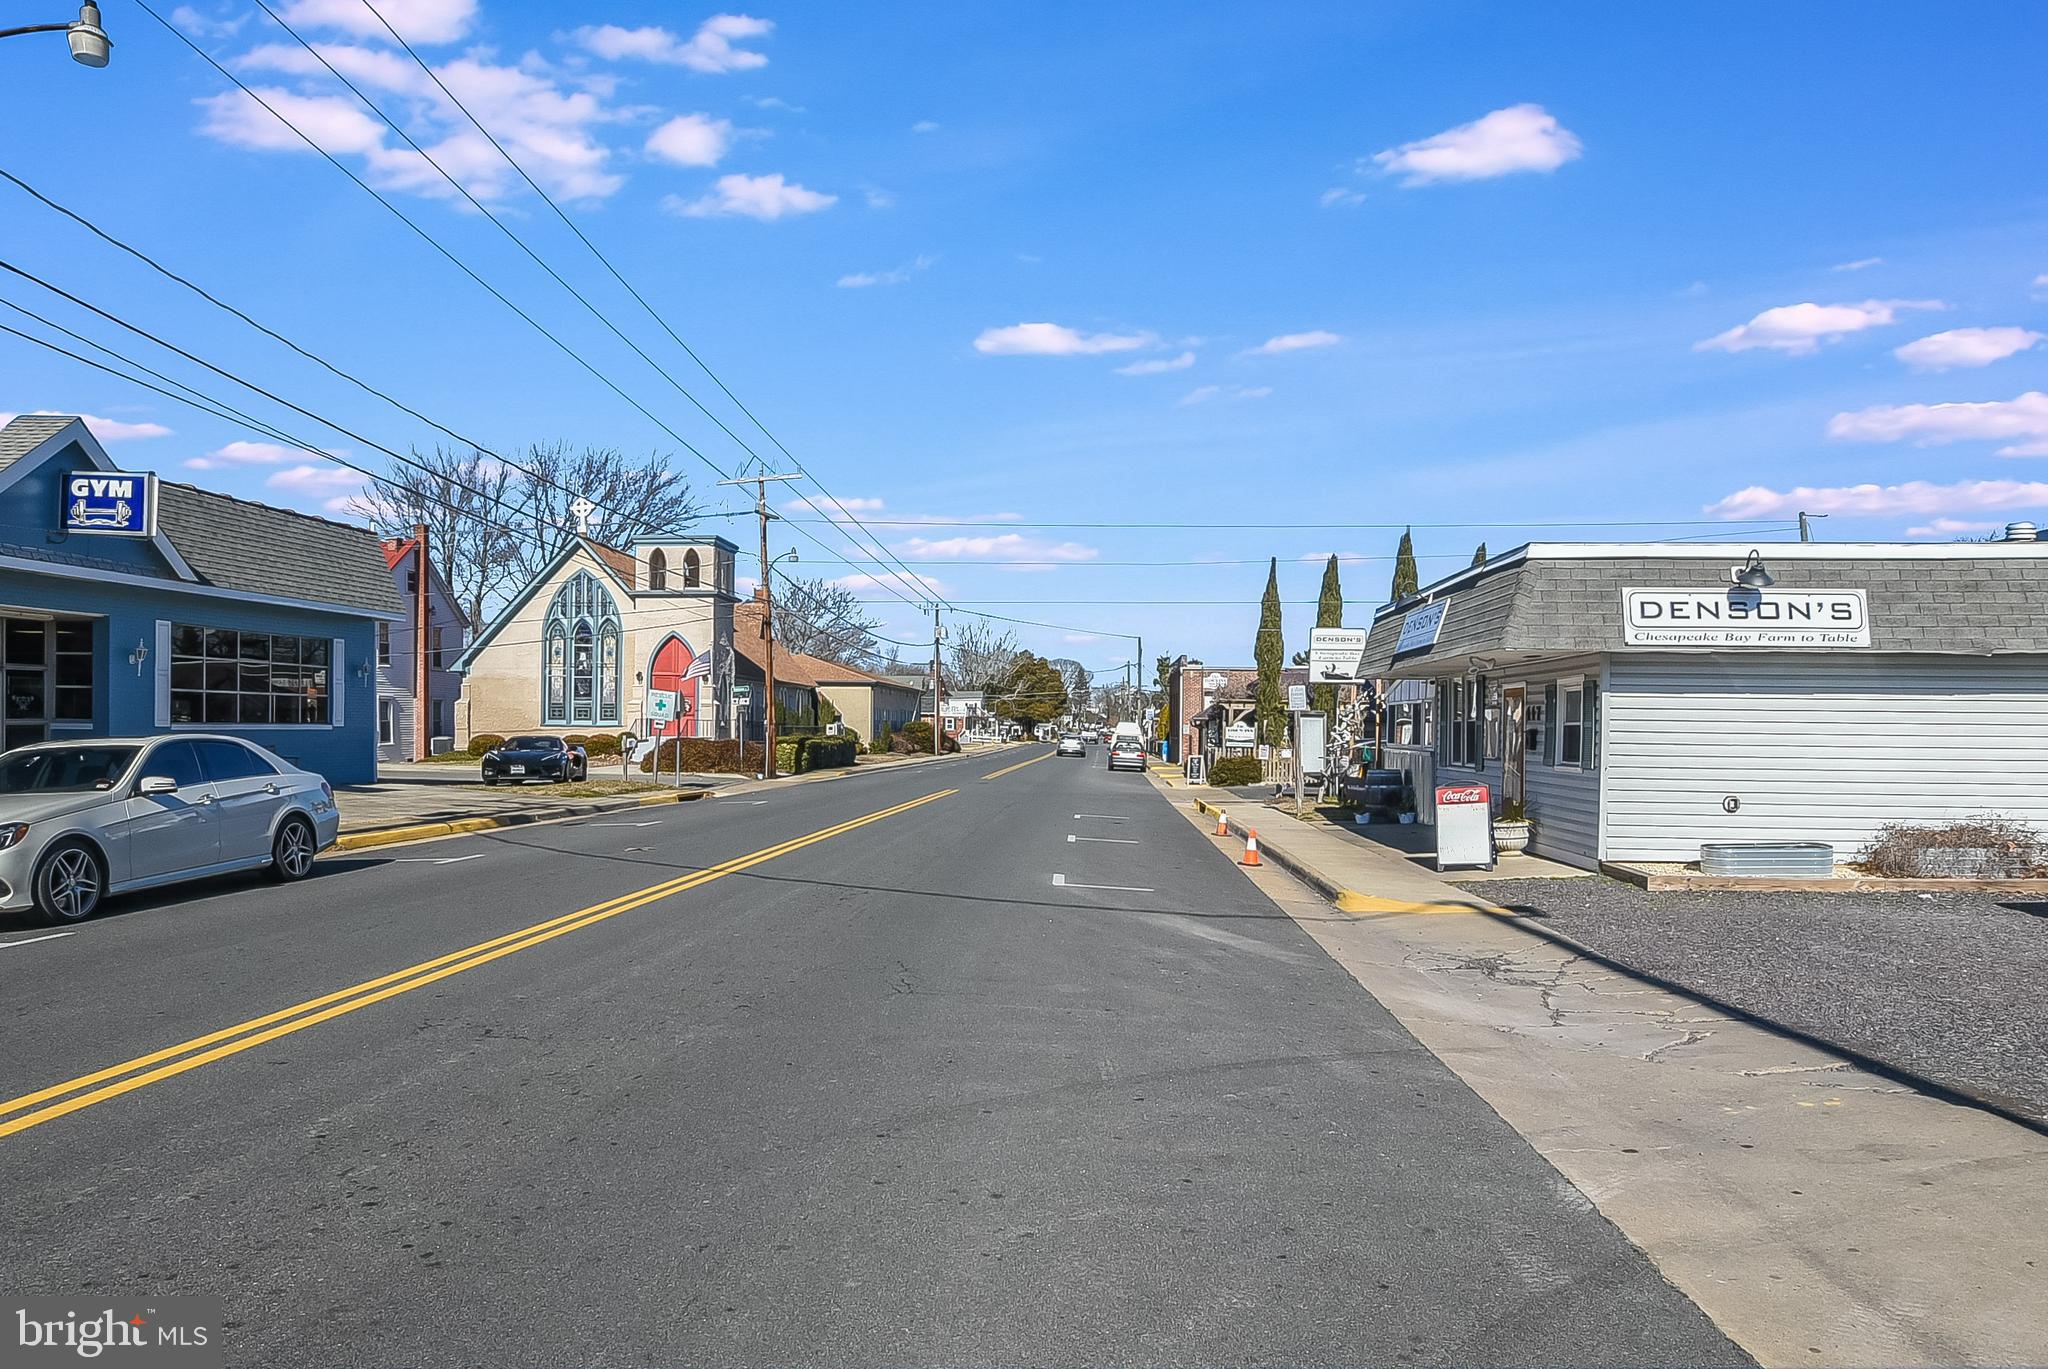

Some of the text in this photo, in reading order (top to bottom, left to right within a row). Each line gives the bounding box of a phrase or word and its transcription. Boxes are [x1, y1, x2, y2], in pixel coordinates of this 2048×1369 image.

[71, 479, 133, 498] GYM
[1640, 601, 1852, 620] DENSON'S
[1403, 610, 1442, 635] DENSON'S
[1634, 632, 1858, 643] Chesapeake Bay Farm to Table
